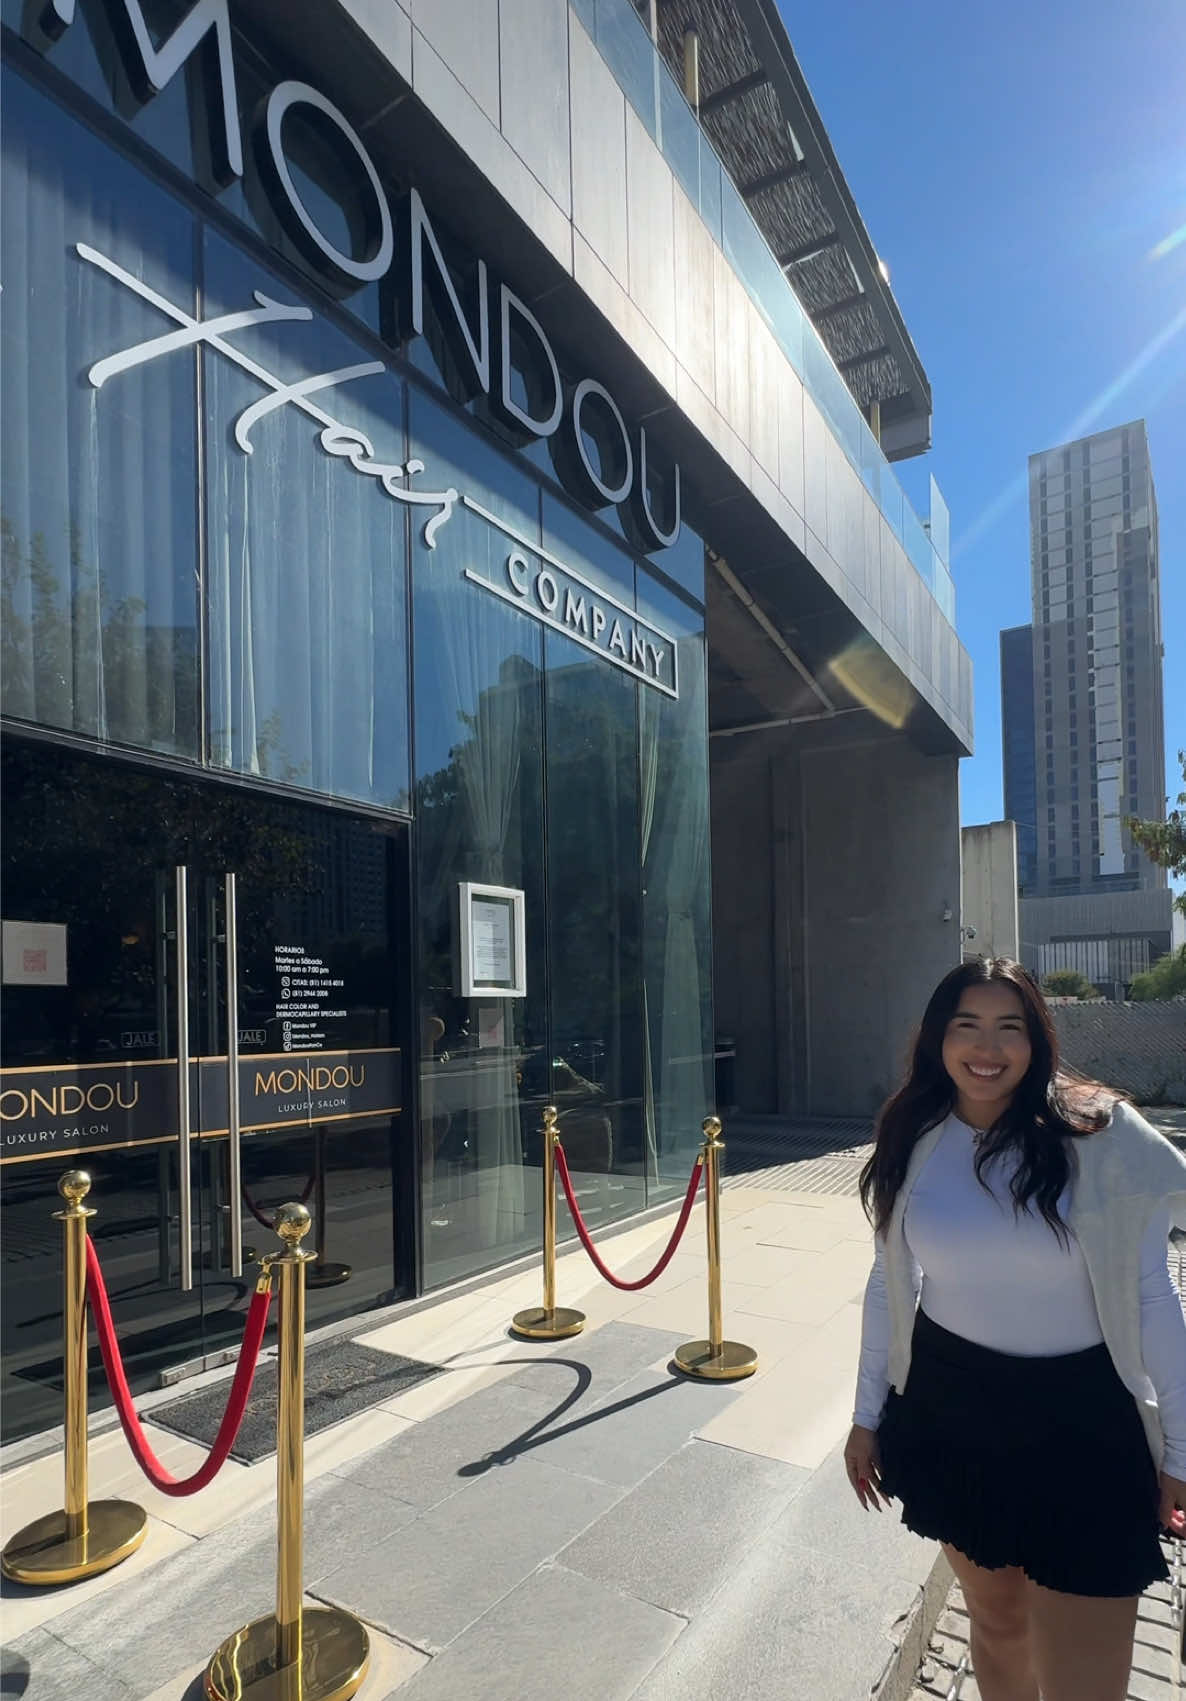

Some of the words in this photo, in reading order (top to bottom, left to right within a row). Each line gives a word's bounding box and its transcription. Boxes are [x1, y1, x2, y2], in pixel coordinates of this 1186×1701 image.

[507, 552, 665, 676] COMPANY
[275, 945, 305, 954] HORARIOS
[275, 956, 295, 964] Martes
[275, 965, 291, 973] 10:00
[255, 1064, 365, 1096] MONDOU
[278, 1101, 313, 1113] LUXURY
[317, 1098, 346, 1109] SALON
[0, 1130, 57, 1146] UXURY
[63, 1123, 109, 1139] SALON
